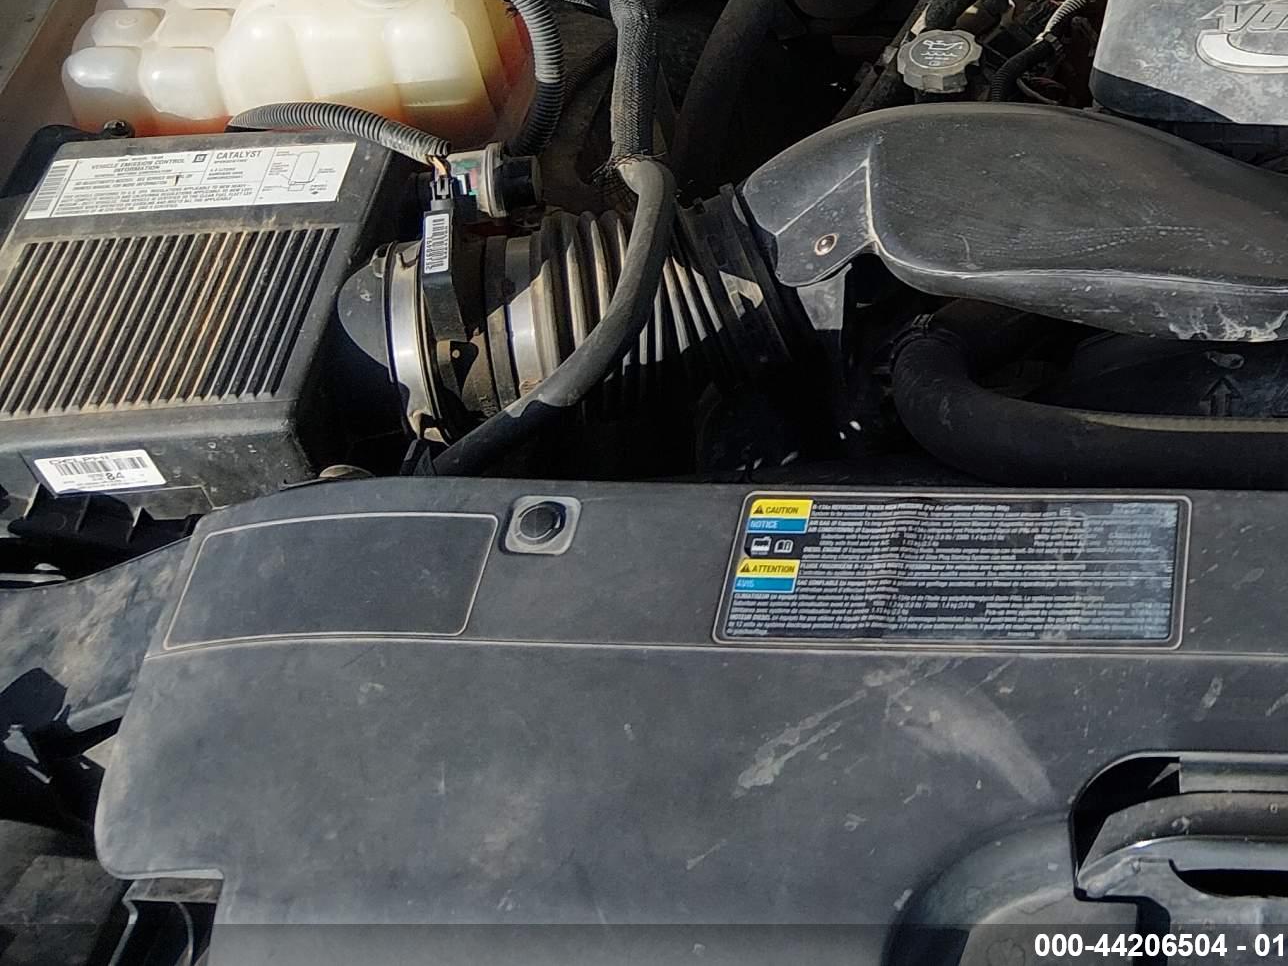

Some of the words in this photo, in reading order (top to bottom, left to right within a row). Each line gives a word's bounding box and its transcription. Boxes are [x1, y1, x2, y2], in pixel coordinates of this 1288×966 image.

[215, 150, 262, 160] CATALYST
[765, 506, 800, 515] CAUTION
[750, 520, 779, 529] NOTICE
[752, 564, 795, 573] ATTENTION
[736, 579, 755, 588] AVIS
